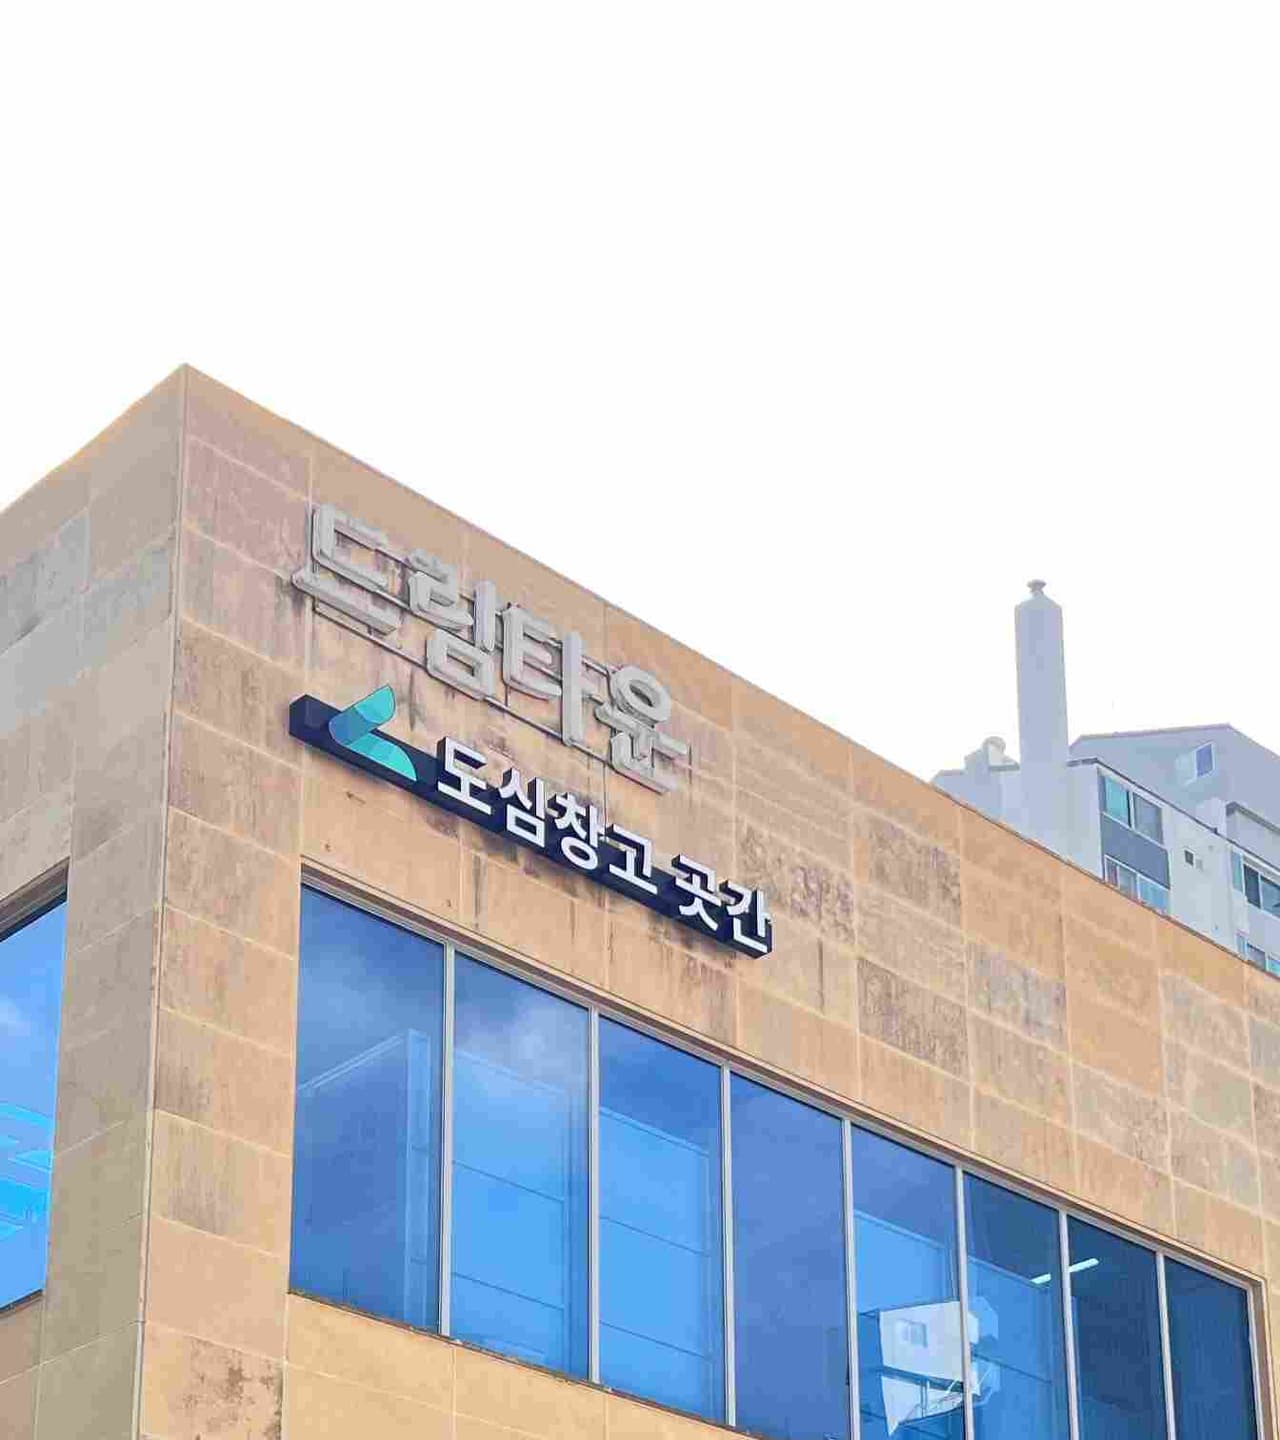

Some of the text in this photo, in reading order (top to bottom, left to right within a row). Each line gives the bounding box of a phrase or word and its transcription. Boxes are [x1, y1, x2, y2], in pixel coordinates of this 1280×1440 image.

[291, 503, 692, 796] 드림타운
[436, 735, 772, 956] 도심창고 곳간
